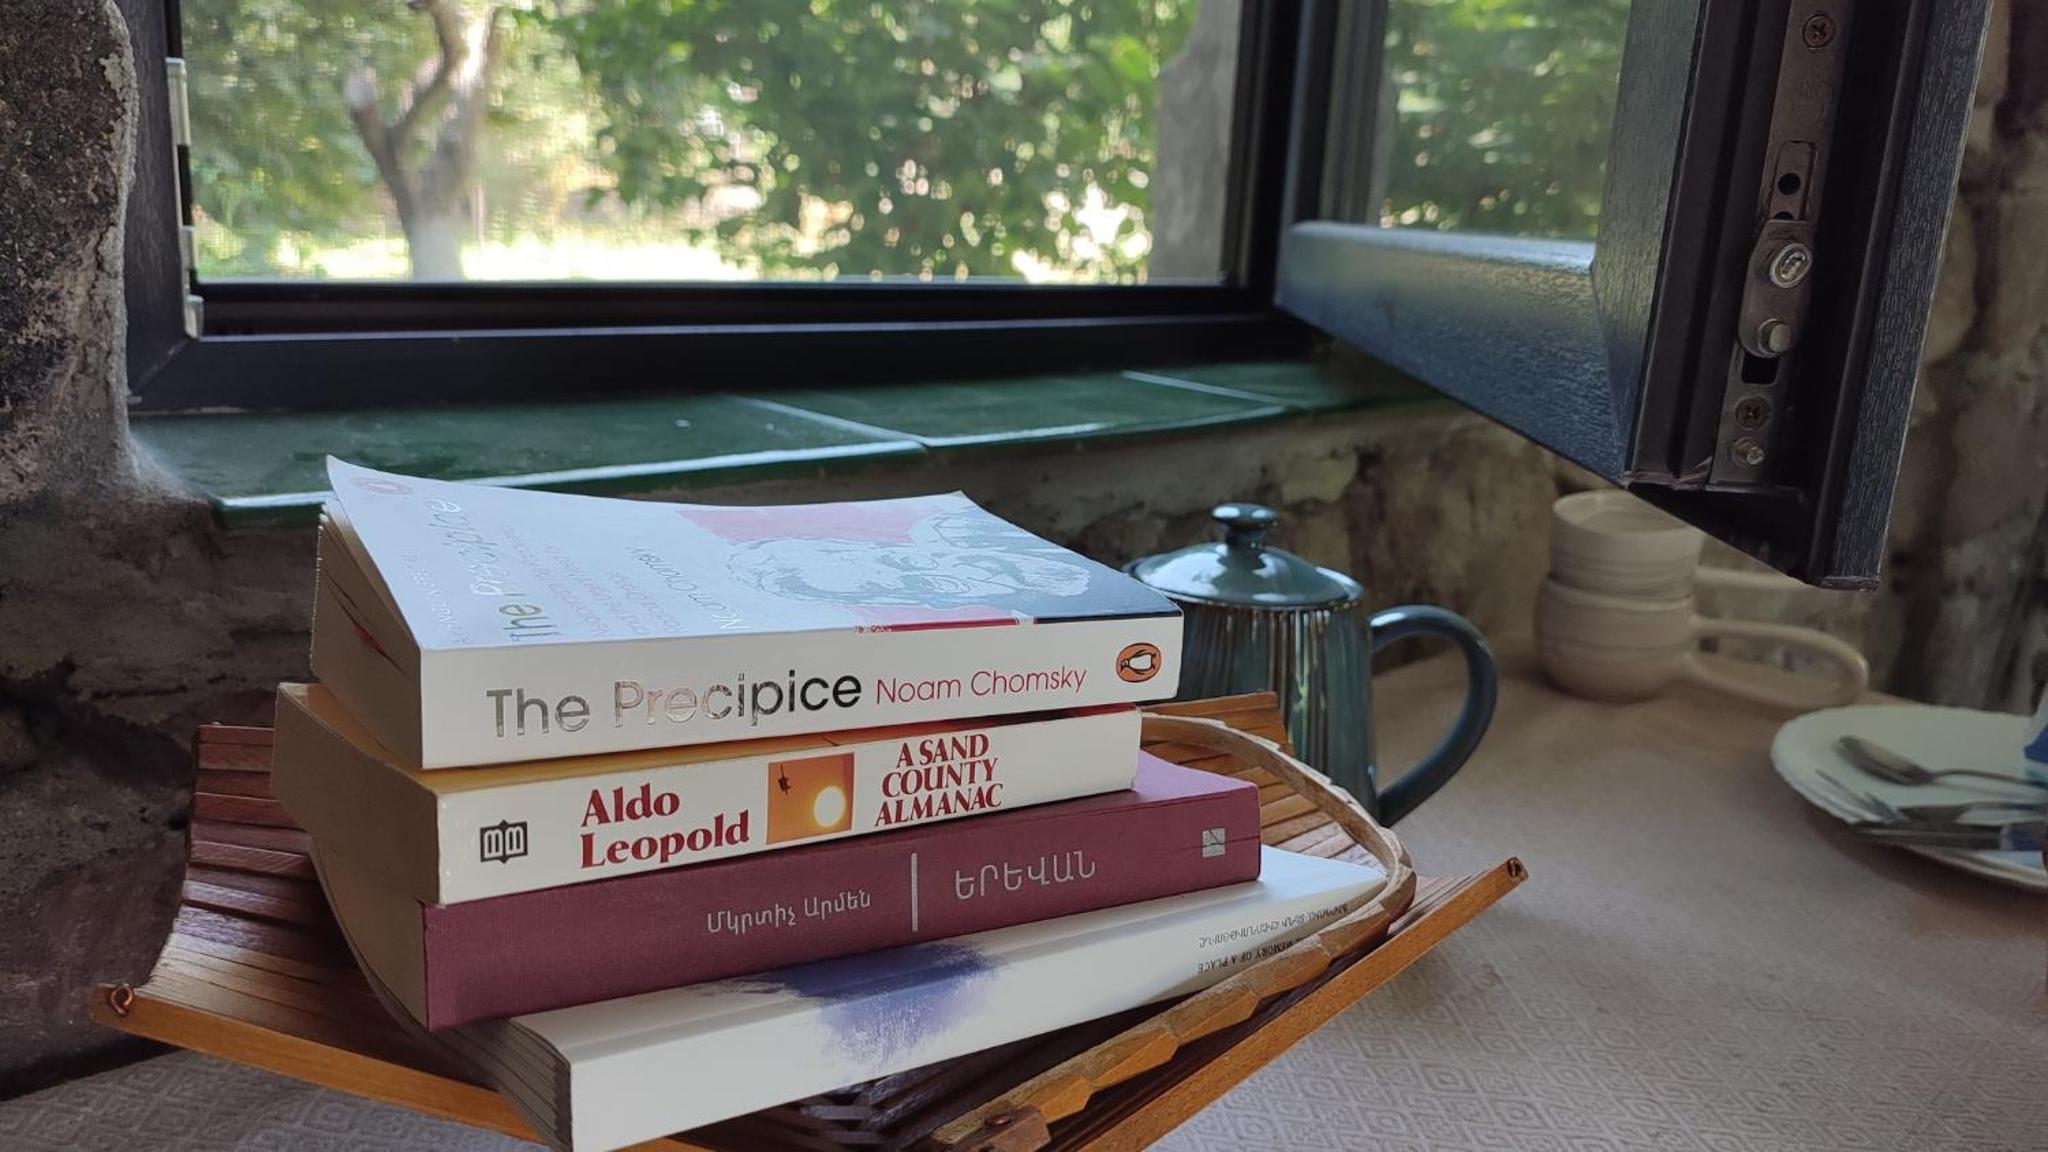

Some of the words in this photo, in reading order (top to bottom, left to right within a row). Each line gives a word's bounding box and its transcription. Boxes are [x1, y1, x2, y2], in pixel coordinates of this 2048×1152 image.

[428, 498, 526, 597] Precipice
[498, 602, 562, 642] The
[486, 688, 590, 738] The
[614, 669, 862, 727] Precipice
[876, 676, 961, 704] Noam
[971, 666, 1087, 695] Chomsky
[896, 742, 914, 769] A
[919, 733, 989, 766] SAND
[882, 757, 999, 798] COUNTY
[580, 783, 680, 827] Aldo
[874, 783, 1004, 827] ALMANAC
[580, 809, 749, 869] Leopold
[707, 903, 796, 934] Մկրտիչ
[804, 892, 872, 918] Արմեն
[954, 854, 1097, 900] ԵՐԵՎԱՆ
